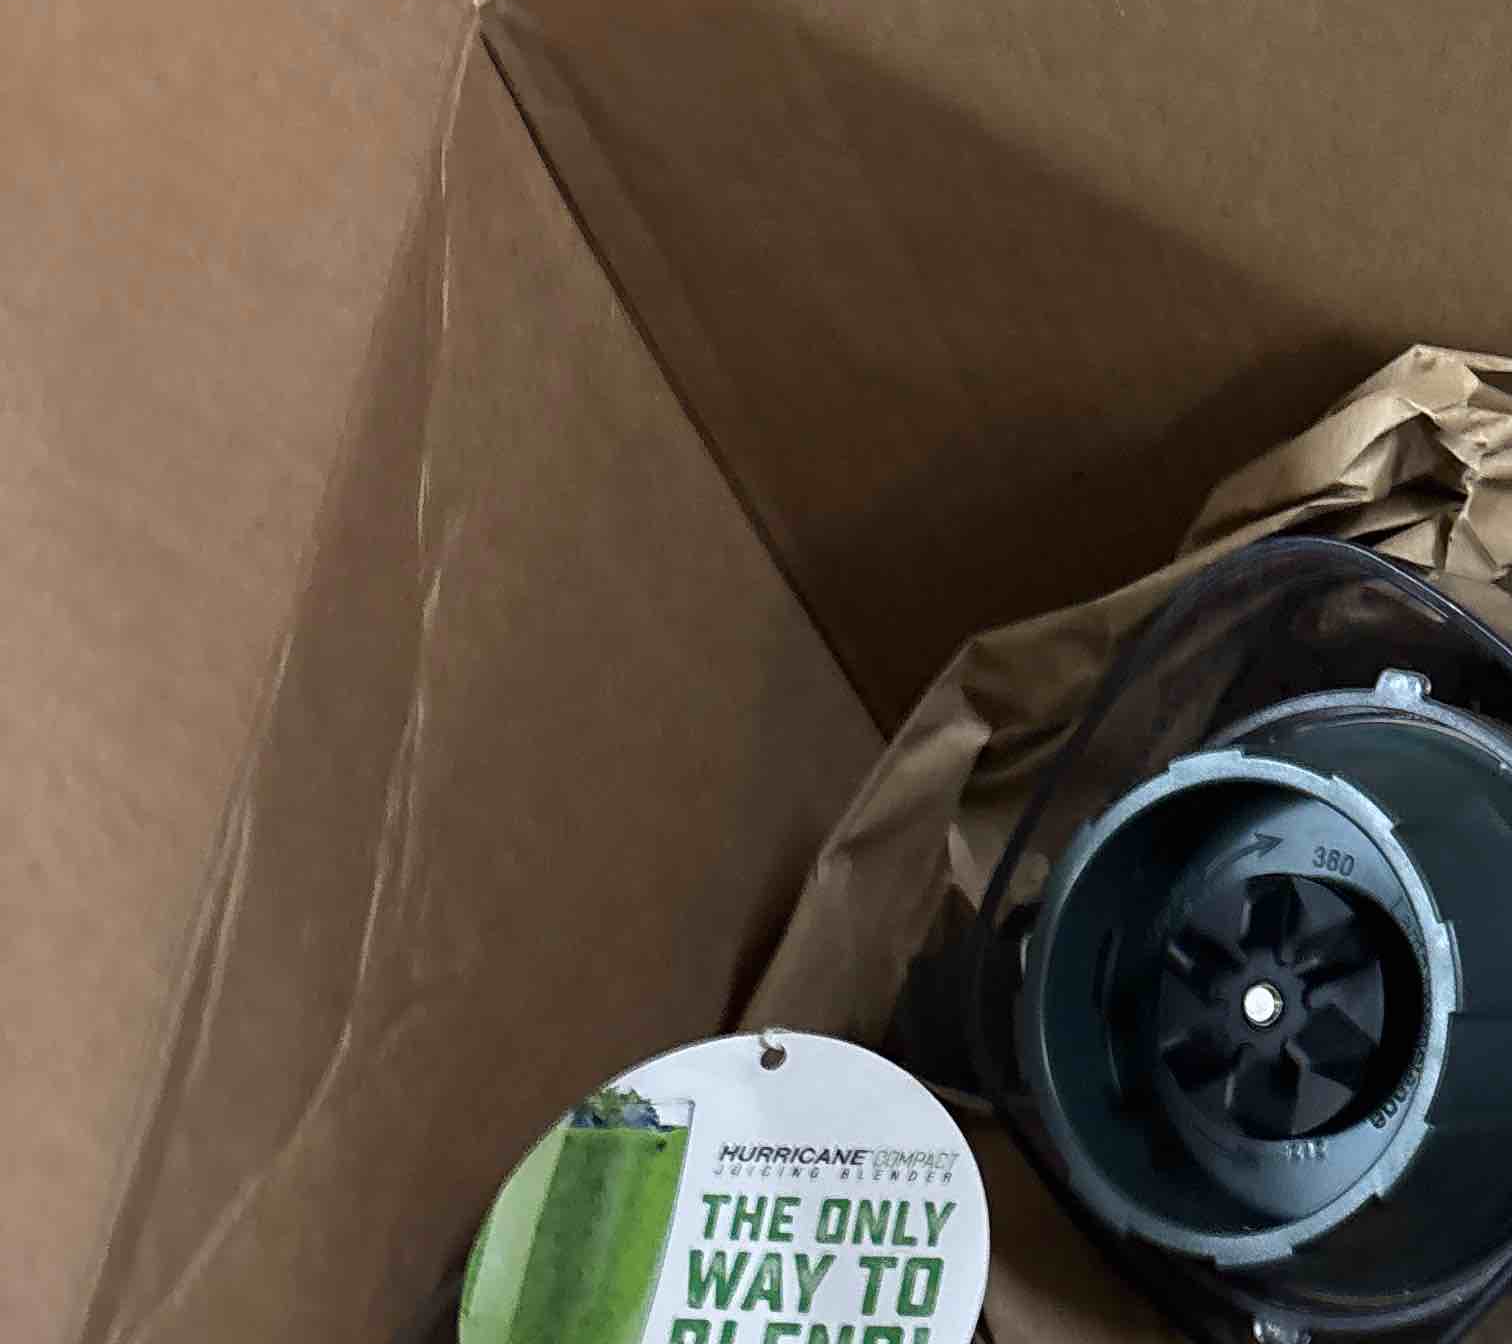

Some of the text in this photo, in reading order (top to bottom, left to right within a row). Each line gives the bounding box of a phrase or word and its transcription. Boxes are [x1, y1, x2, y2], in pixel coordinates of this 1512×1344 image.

[713, 1164, 953, 1184] JUICING BLENDER
[718, 1144, 961, 1170] HURRICANE COMPACT
[701, 1193, 957, 1248] THE ONLY
[686, 1248, 945, 1317] WAY TO
